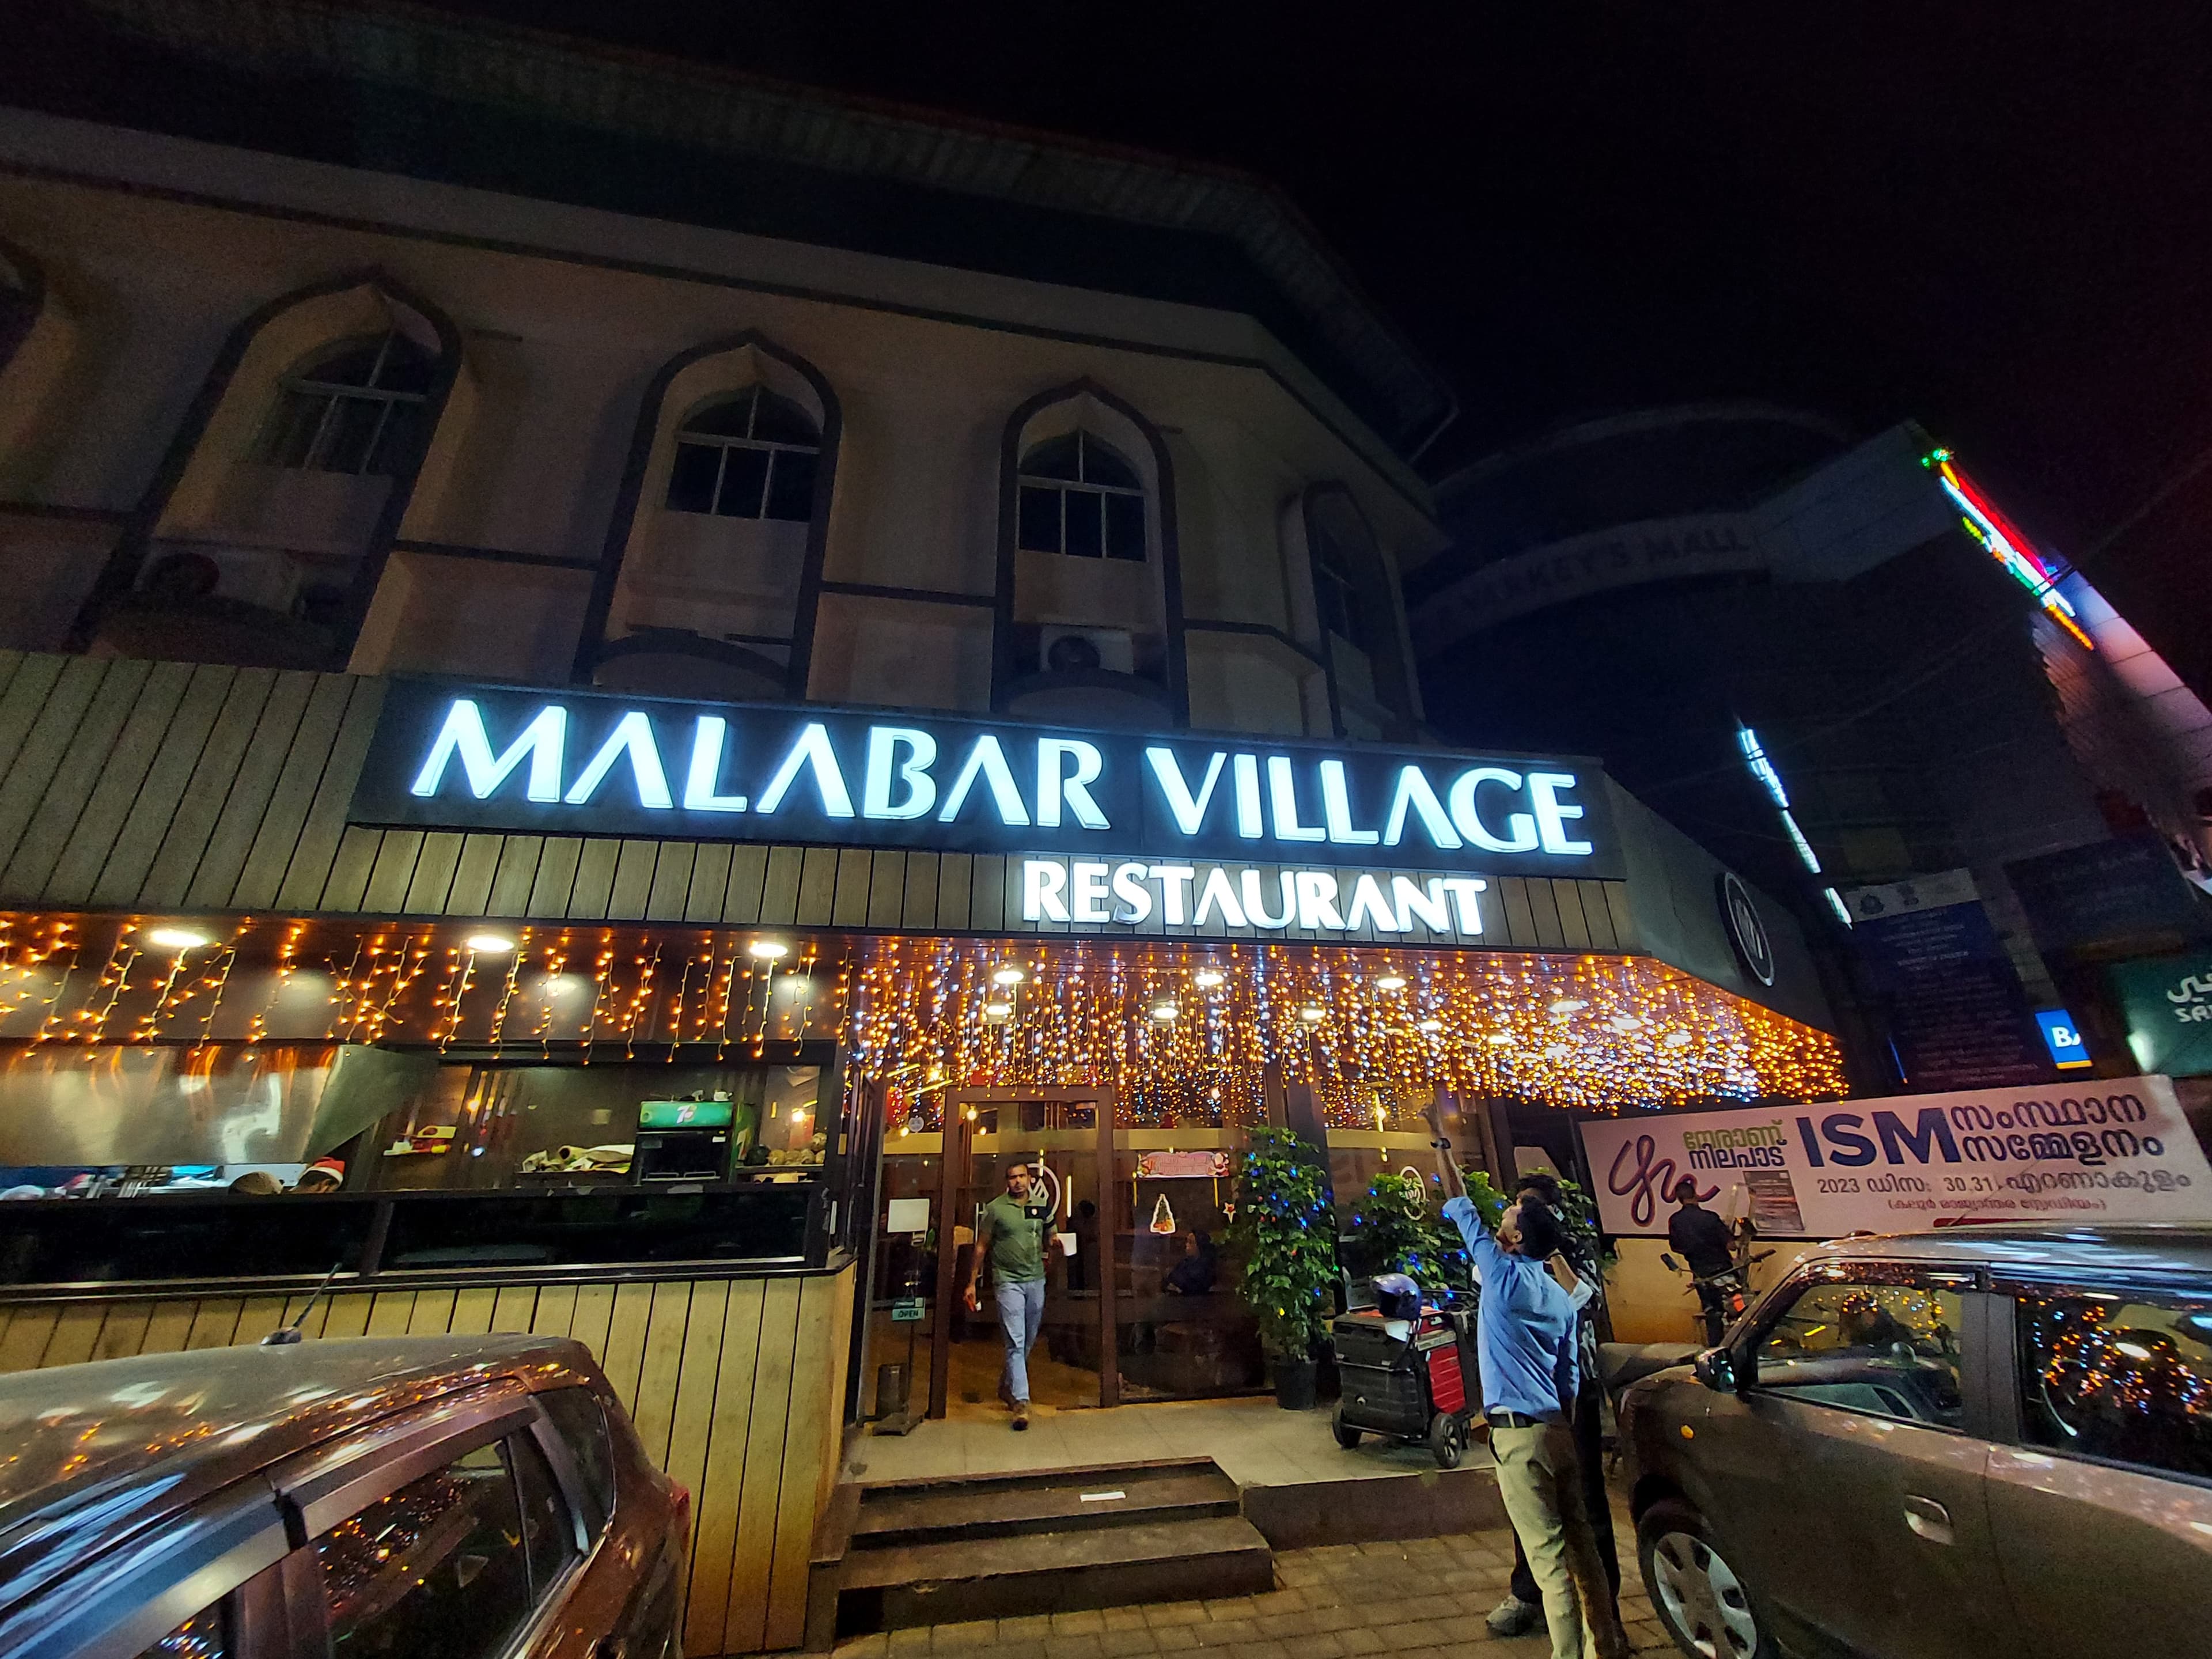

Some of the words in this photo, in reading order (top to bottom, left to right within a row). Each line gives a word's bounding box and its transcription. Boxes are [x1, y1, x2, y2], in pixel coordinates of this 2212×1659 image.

[1643, 527, 1751, 565] MALL
[411, 699, 1109, 830] MALABAR
[1146, 747, 1592, 855] VILLAGE
[1023, 860, 1487, 935] RESTAURANT
[1950, 1094, 2146, 1131] സംസ്ഥാന
[1689, 1138, 1787, 1169] നിലപാട്
[1796, 1107, 1962, 1168] ISM
[1962, 1128, 2164, 1166] സമ്മേളനം
[1817, 1178, 1860, 1193] 2023
[2006, 1169, 2191, 1194] എറണാകുളം
